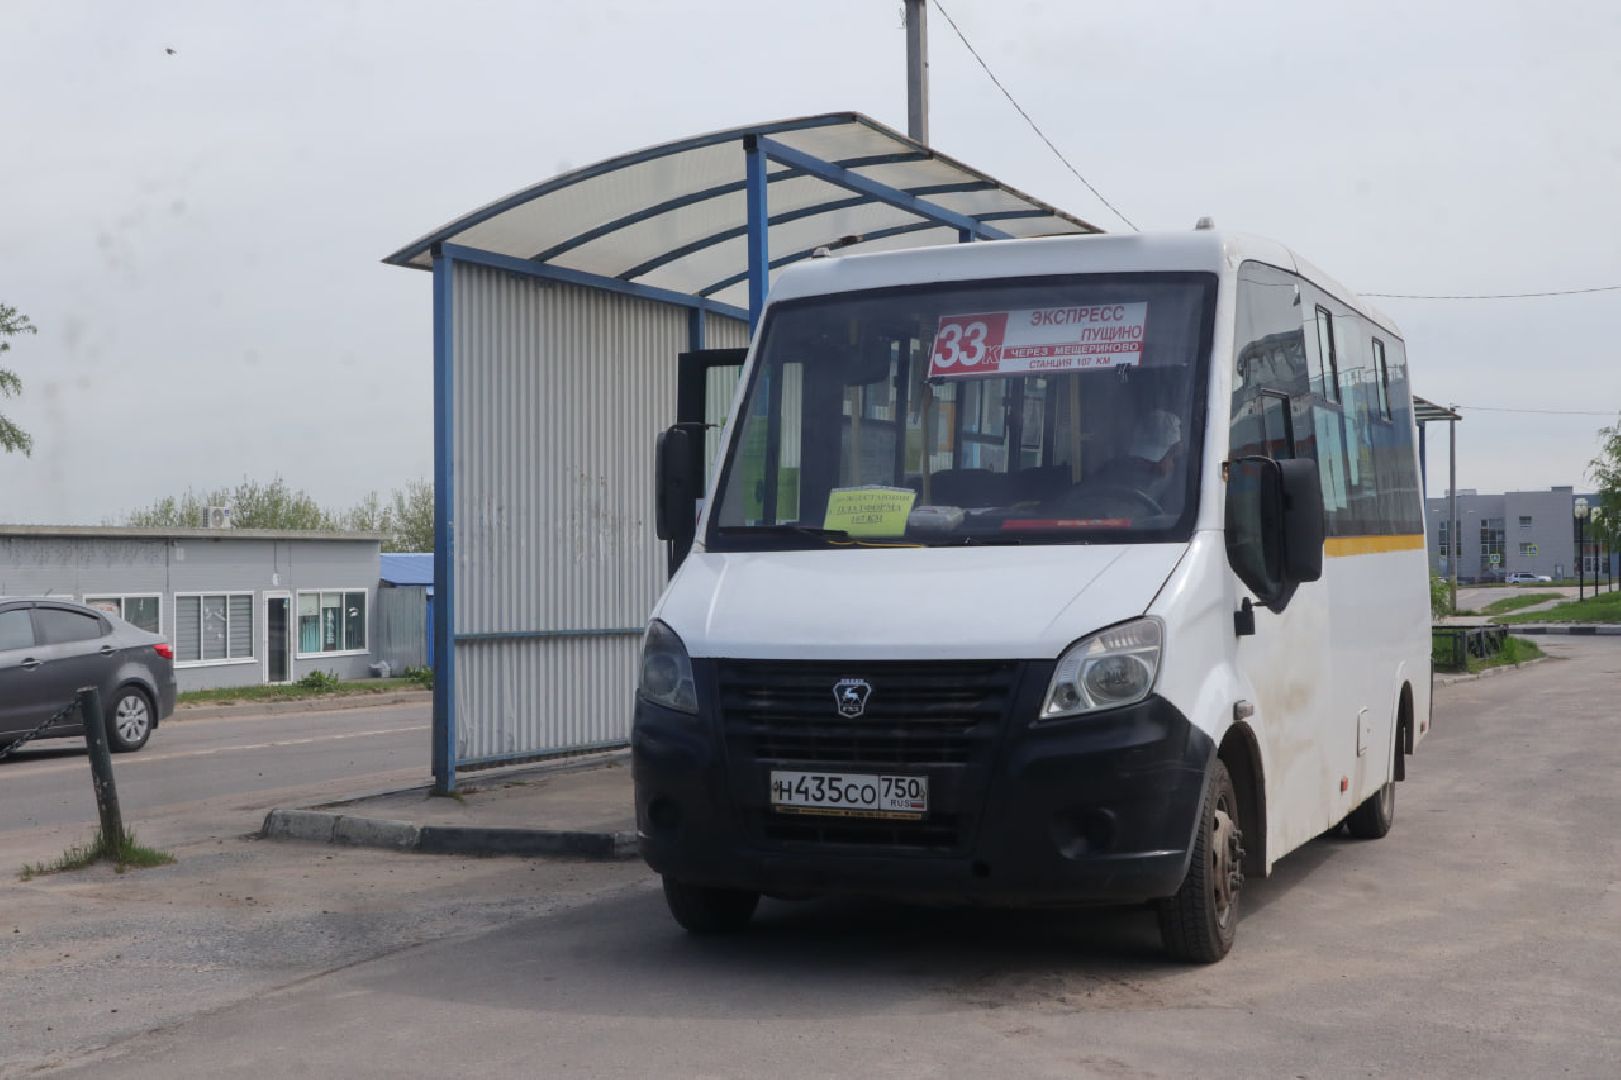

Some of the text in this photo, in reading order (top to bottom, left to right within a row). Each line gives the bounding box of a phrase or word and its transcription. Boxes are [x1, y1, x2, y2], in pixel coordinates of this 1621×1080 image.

[1030, 306, 1125, 326] ЭКСПРЕСС
[1081, 325, 1143, 342] ПУЩИНО
[1010, 343, 1139, 358] ЧЕРЕЗ МЕЩЕРИНОВО
[1029, 357, 1072, 369] СТАНЦИЯ
[1096, 356, 1111, 365] КМ
[779, 776, 920, 804] Н435СО 750
[890, 800, 910, 808] RUS
